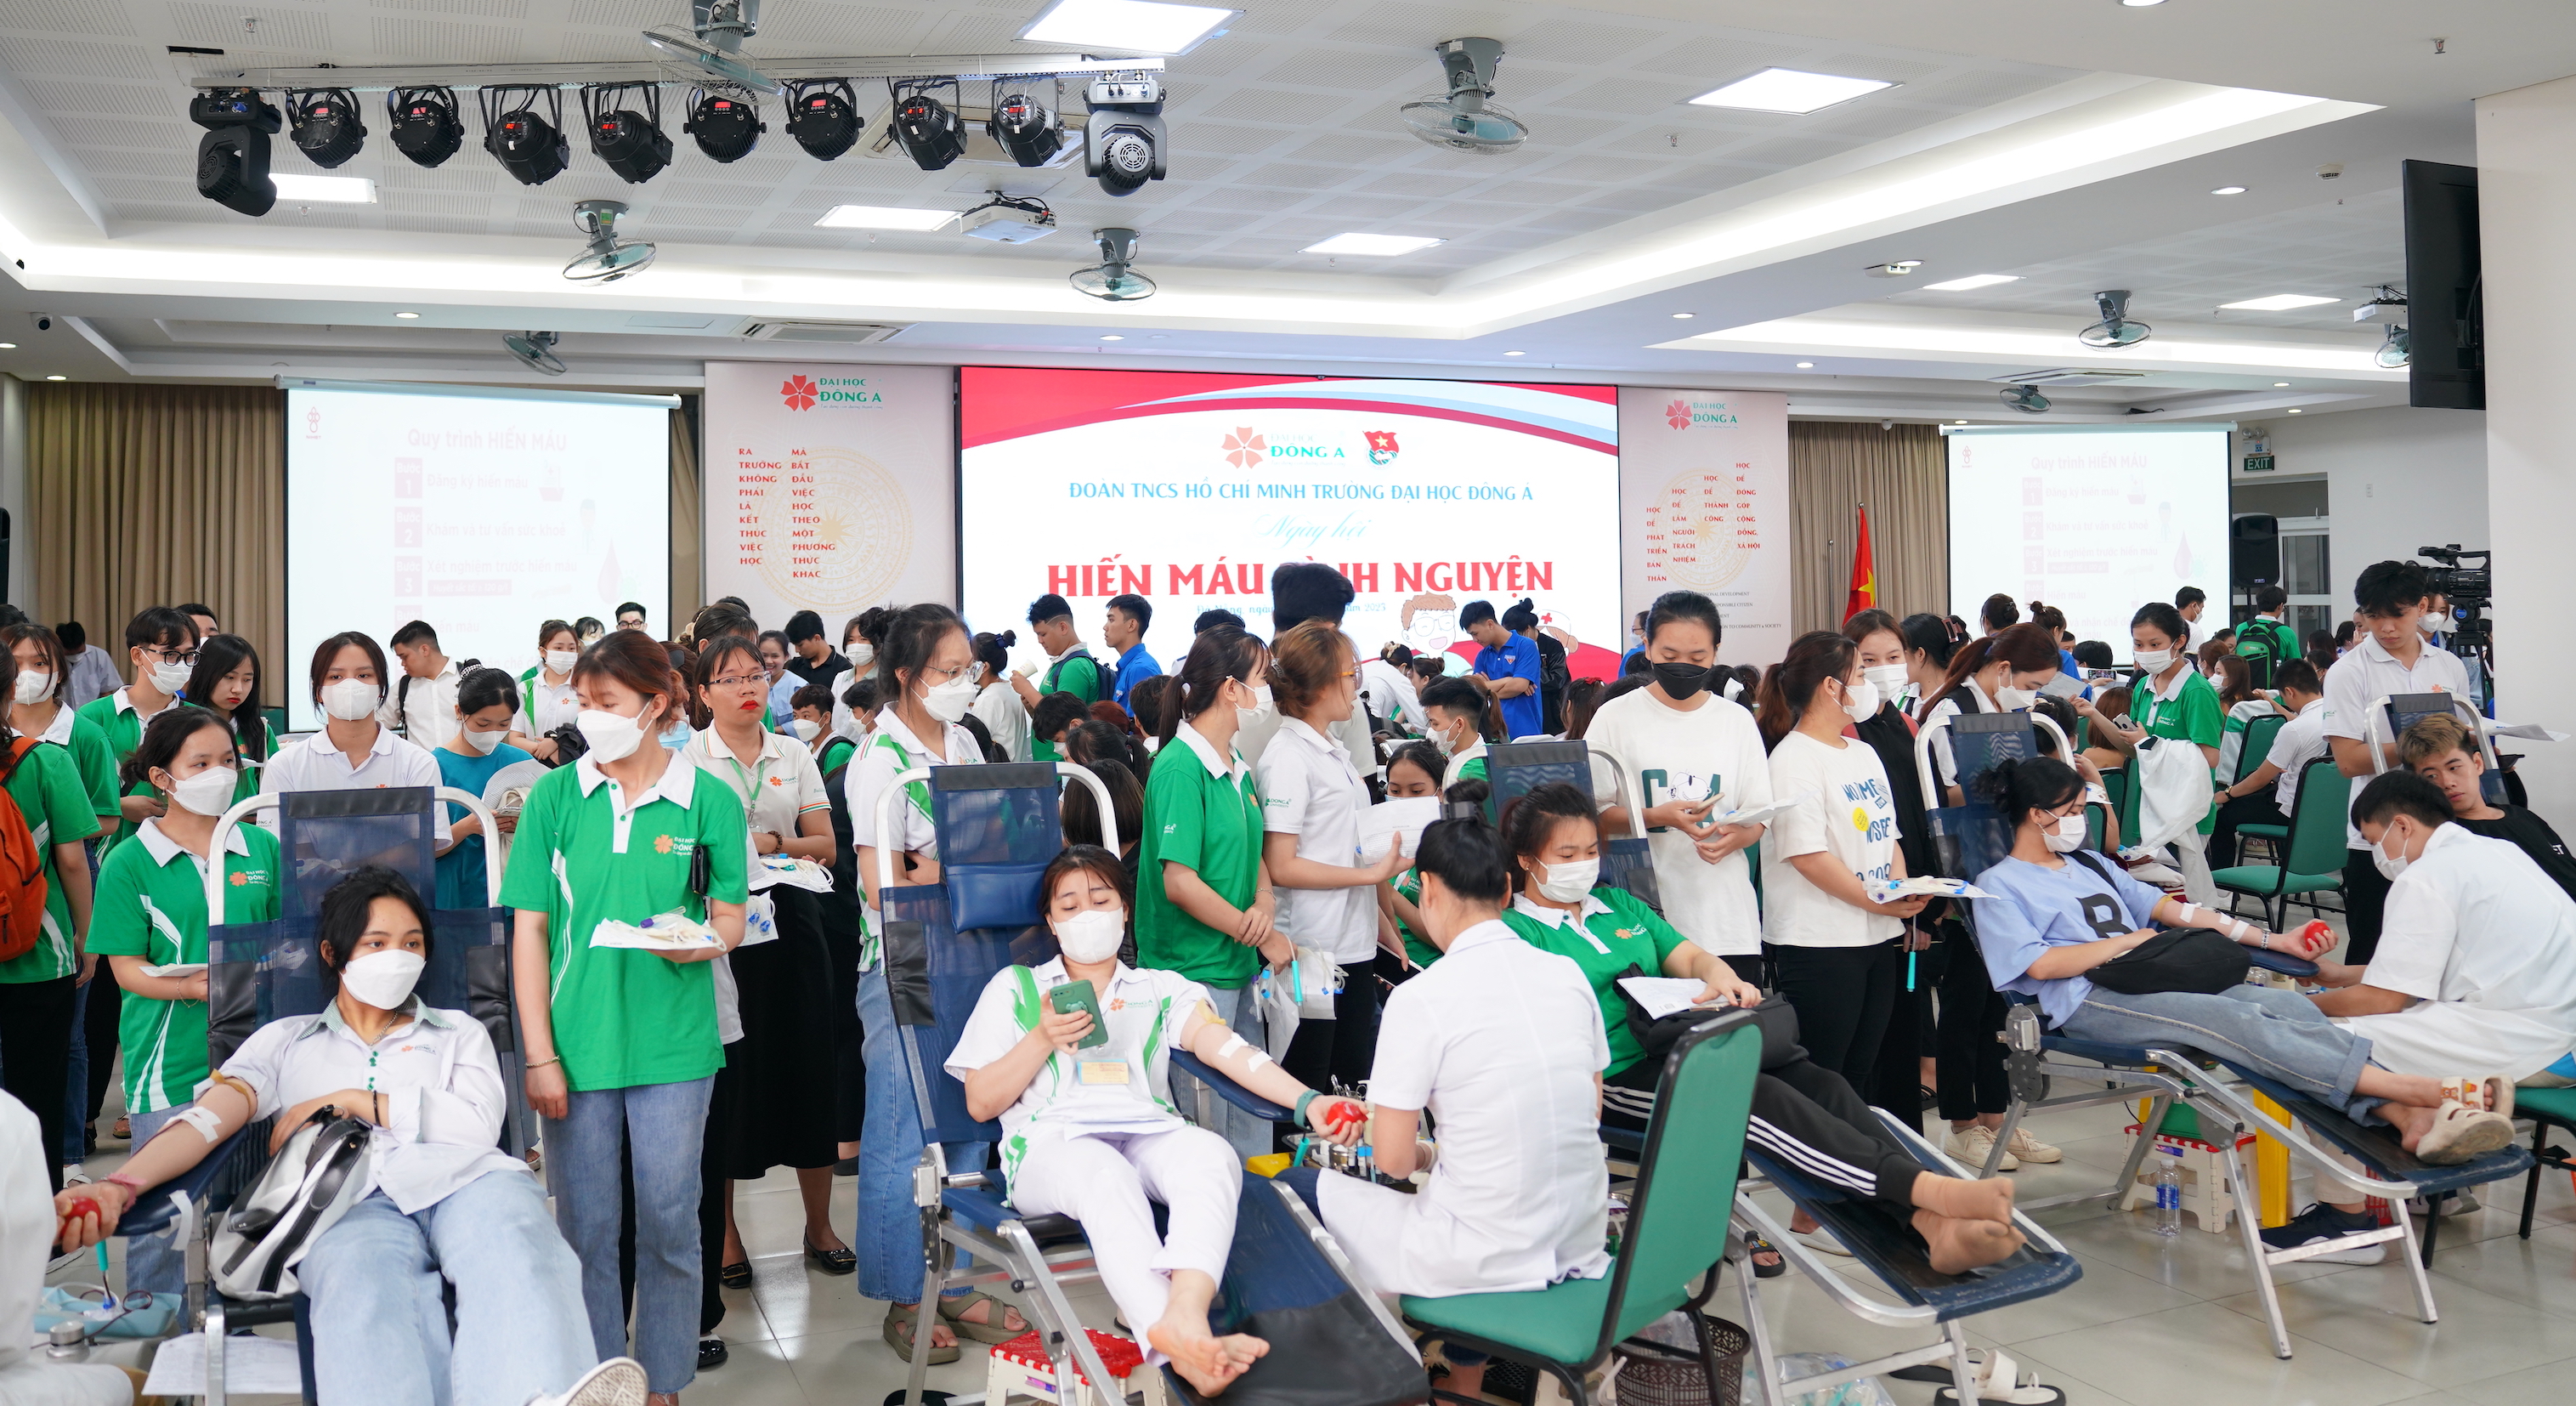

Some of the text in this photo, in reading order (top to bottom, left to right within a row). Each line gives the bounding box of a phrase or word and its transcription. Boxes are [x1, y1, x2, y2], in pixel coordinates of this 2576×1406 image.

[819, 377, 867, 388] ĐẠI HỌC
[819, 388, 882, 402] ĐÔNG Á
[1693, 411, 1727, 423] ĐÔNG
[408, 425, 567, 451] Quy trình HIẾN MÁU
[1271, 443, 1328, 458] ĐÔNG
[739, 460, 782, 469] TRƯỜNG
[2031, 451, 2148, 472] Quy trình HIẾN MÁU
[2247, 458, 2270, 470] EXIT
[461, 475, 473, 490] ký
[505, 475, 529, 489] máu
[739, 473, 777, 483] KHÔNG
[792, 488, 815, 498] VIỆC
[1069, 476, 1533, 504] ĐOÀN TNCS HỒ CHÍ MINH TRƯỜNG ĐẠI HỌC ĐÔNG Á
[2102, 485, 2119, 496] máu
[792, 503, 814, 512] HỌC
[739, 513, 759, 524] KẾT
[427, 524, 459, 537] Khám
[463, 524, 476, 536] và
[1252, 511, 1374, 552] Ngày hội
[2046, 521, 2069, 531] Khám
[2072, 522, 2081, 531] và
[405, 529, 413, 543] 2
[739, 529, 767, 537] THÚC
[792, 529, 814, 539] MỘT
[739, 542, 763, 553] VIỆC
[2141, 546, 2158, 556] máu
[427, 558, 446, 573] Xét
[450, 558, 492, 576] nghiệm
[555, 559, 577, 573] máu
[740, 558, 762, 566] HỌC
[793, 569, 821, 578] KHÁC
[1048, 554, 1553, 598] HIẾN MÁU NGUYỆN
[405, 578, 413, 593] 3
[1364, 602, 1386, 612] 2023
